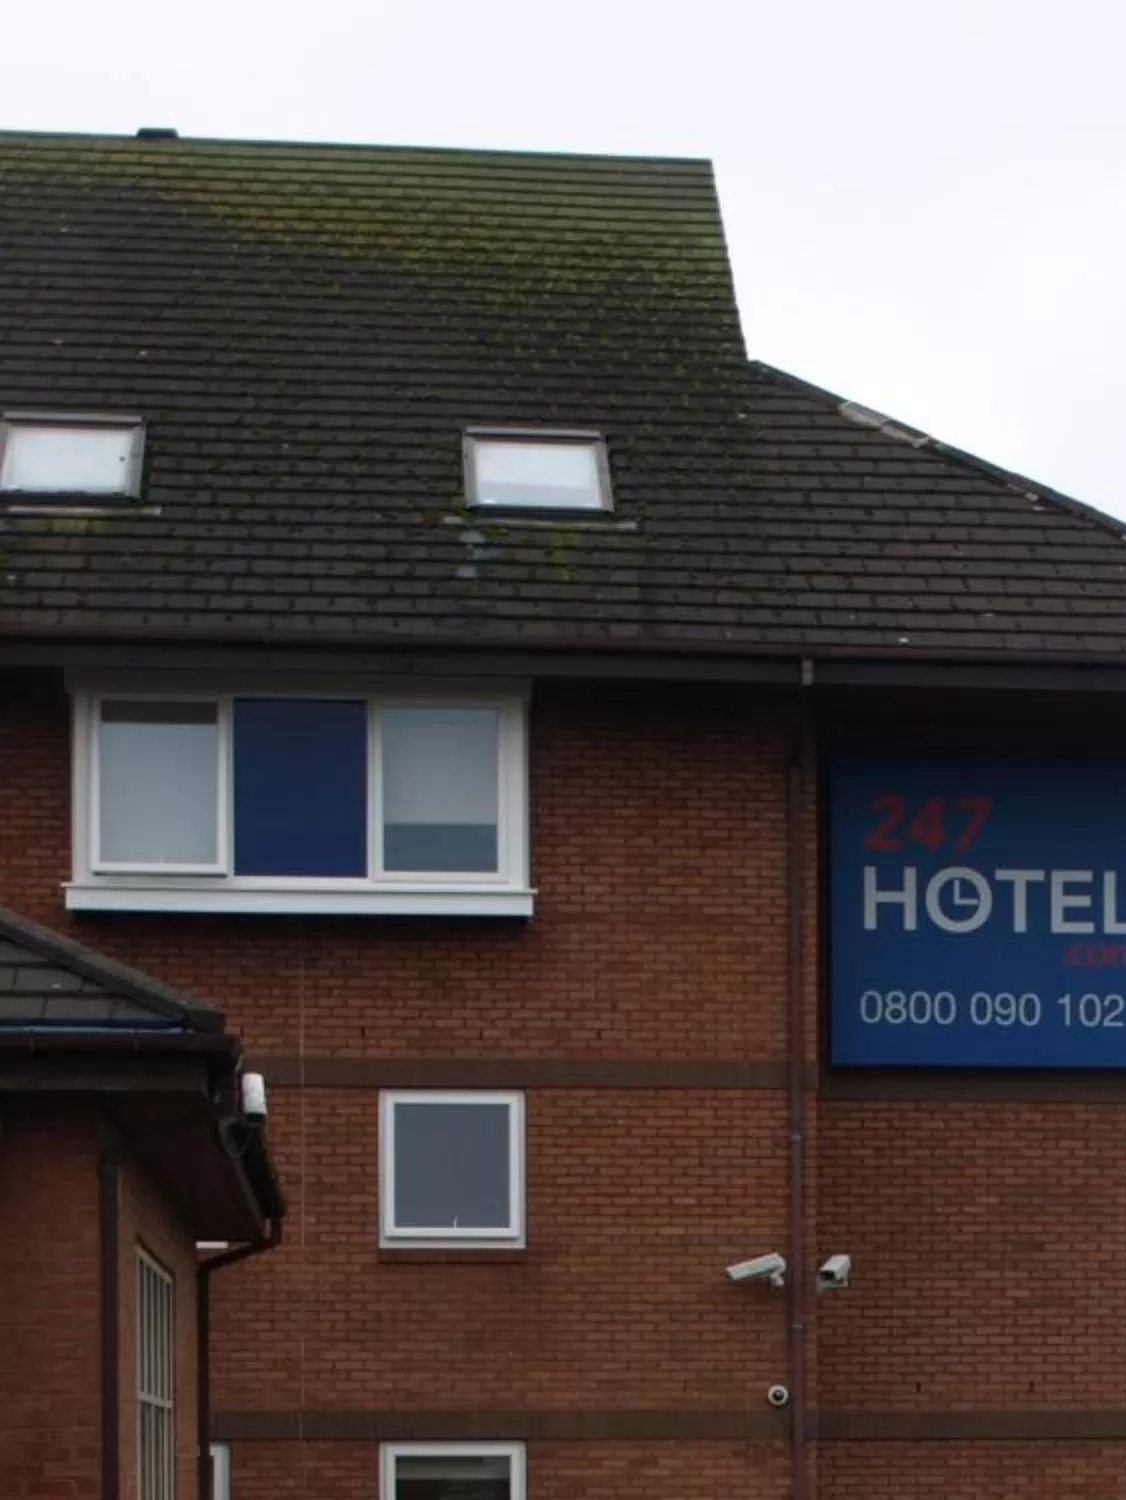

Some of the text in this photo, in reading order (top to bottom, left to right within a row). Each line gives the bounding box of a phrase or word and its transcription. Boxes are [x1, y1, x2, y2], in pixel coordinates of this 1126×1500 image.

[864, 795, 993, 855] 247
[859, 990, 957, 1024] 0800
[970, 992, 1041, 1026] 090
